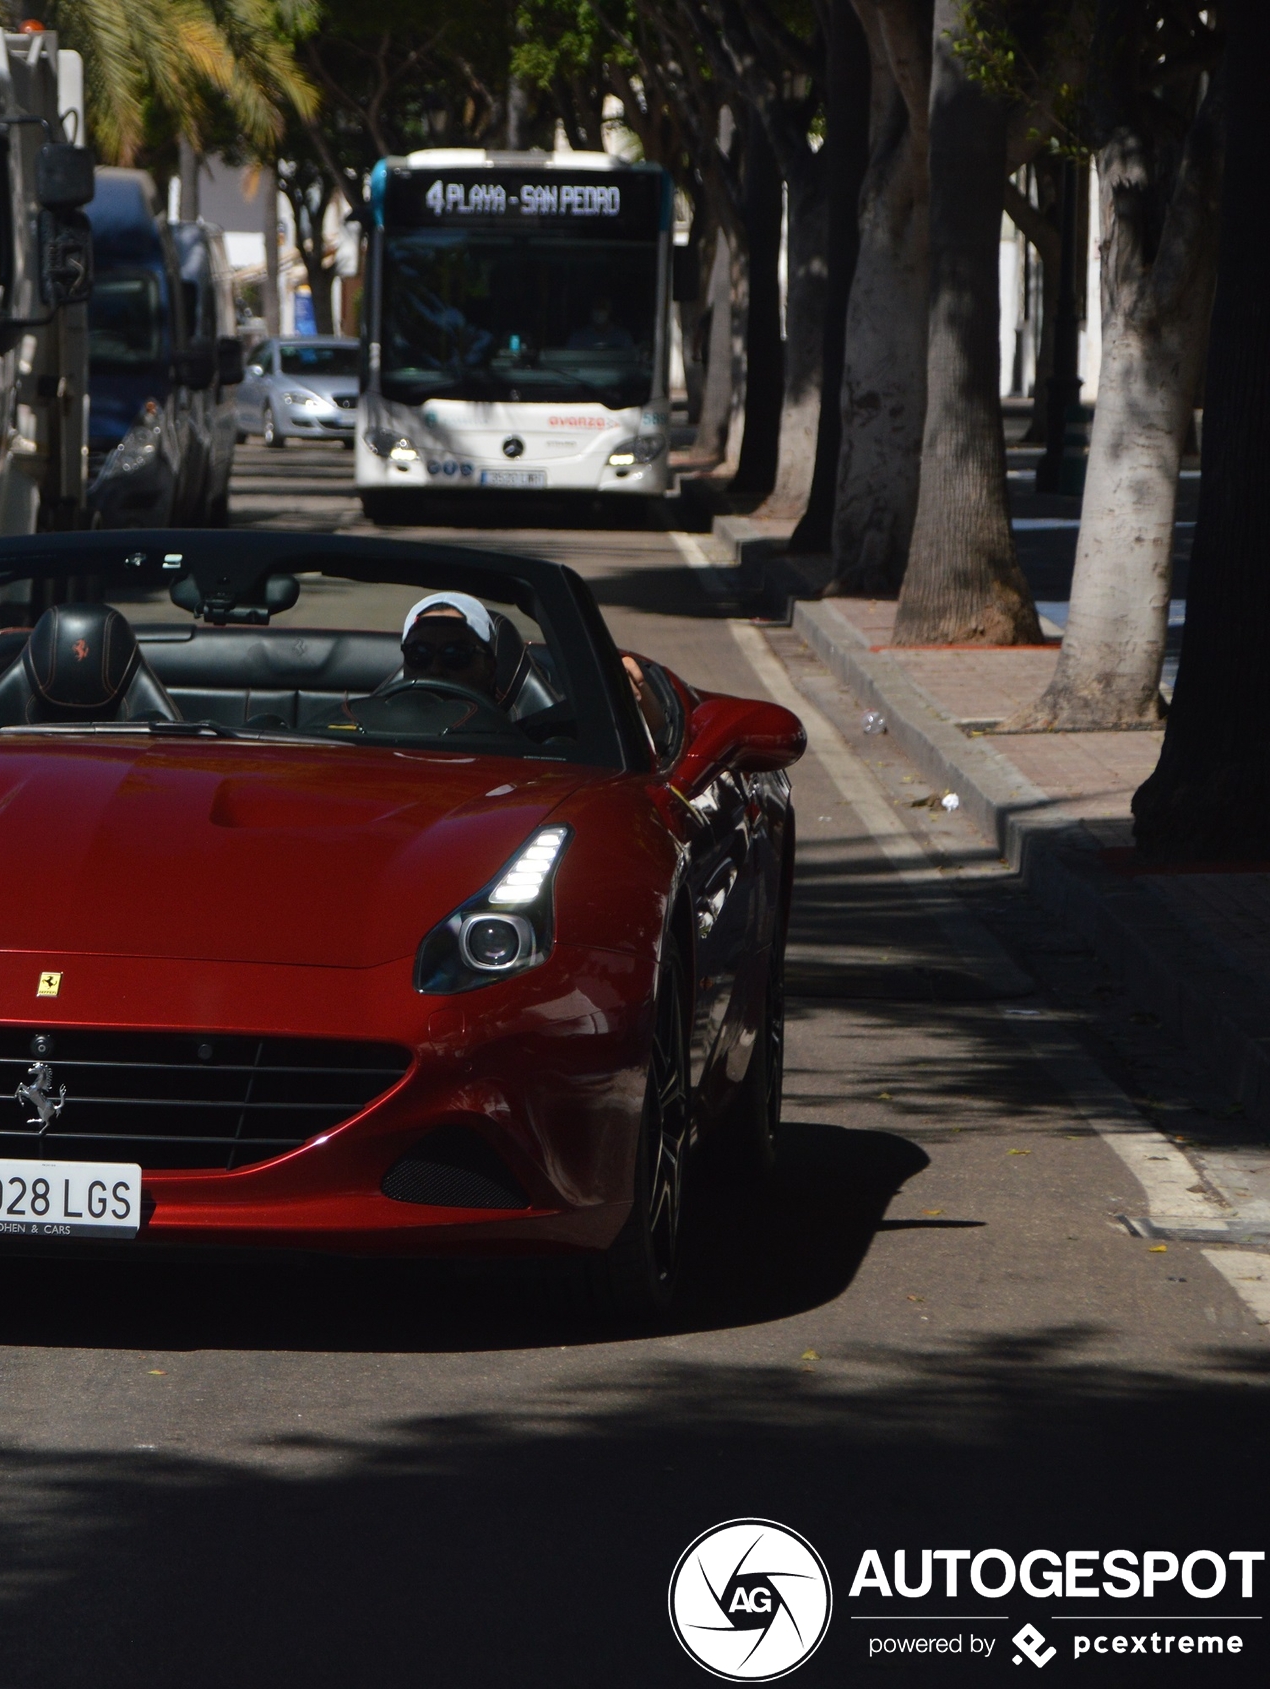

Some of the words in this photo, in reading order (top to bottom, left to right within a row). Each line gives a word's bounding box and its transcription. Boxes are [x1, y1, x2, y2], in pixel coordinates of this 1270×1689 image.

[426, 180, 445, 216] 4
[446, 183, 506, 214] PLAYA
[520, 185, 558, 215] SAN
[559, 185, 620, 216] PEDRO
[548, 416, 605, 429] avanza
[64, 1178, 131, 1219] LGS
[31, 1224, 39, 1234] &
[43, 1225, 71, 1235] CARS
